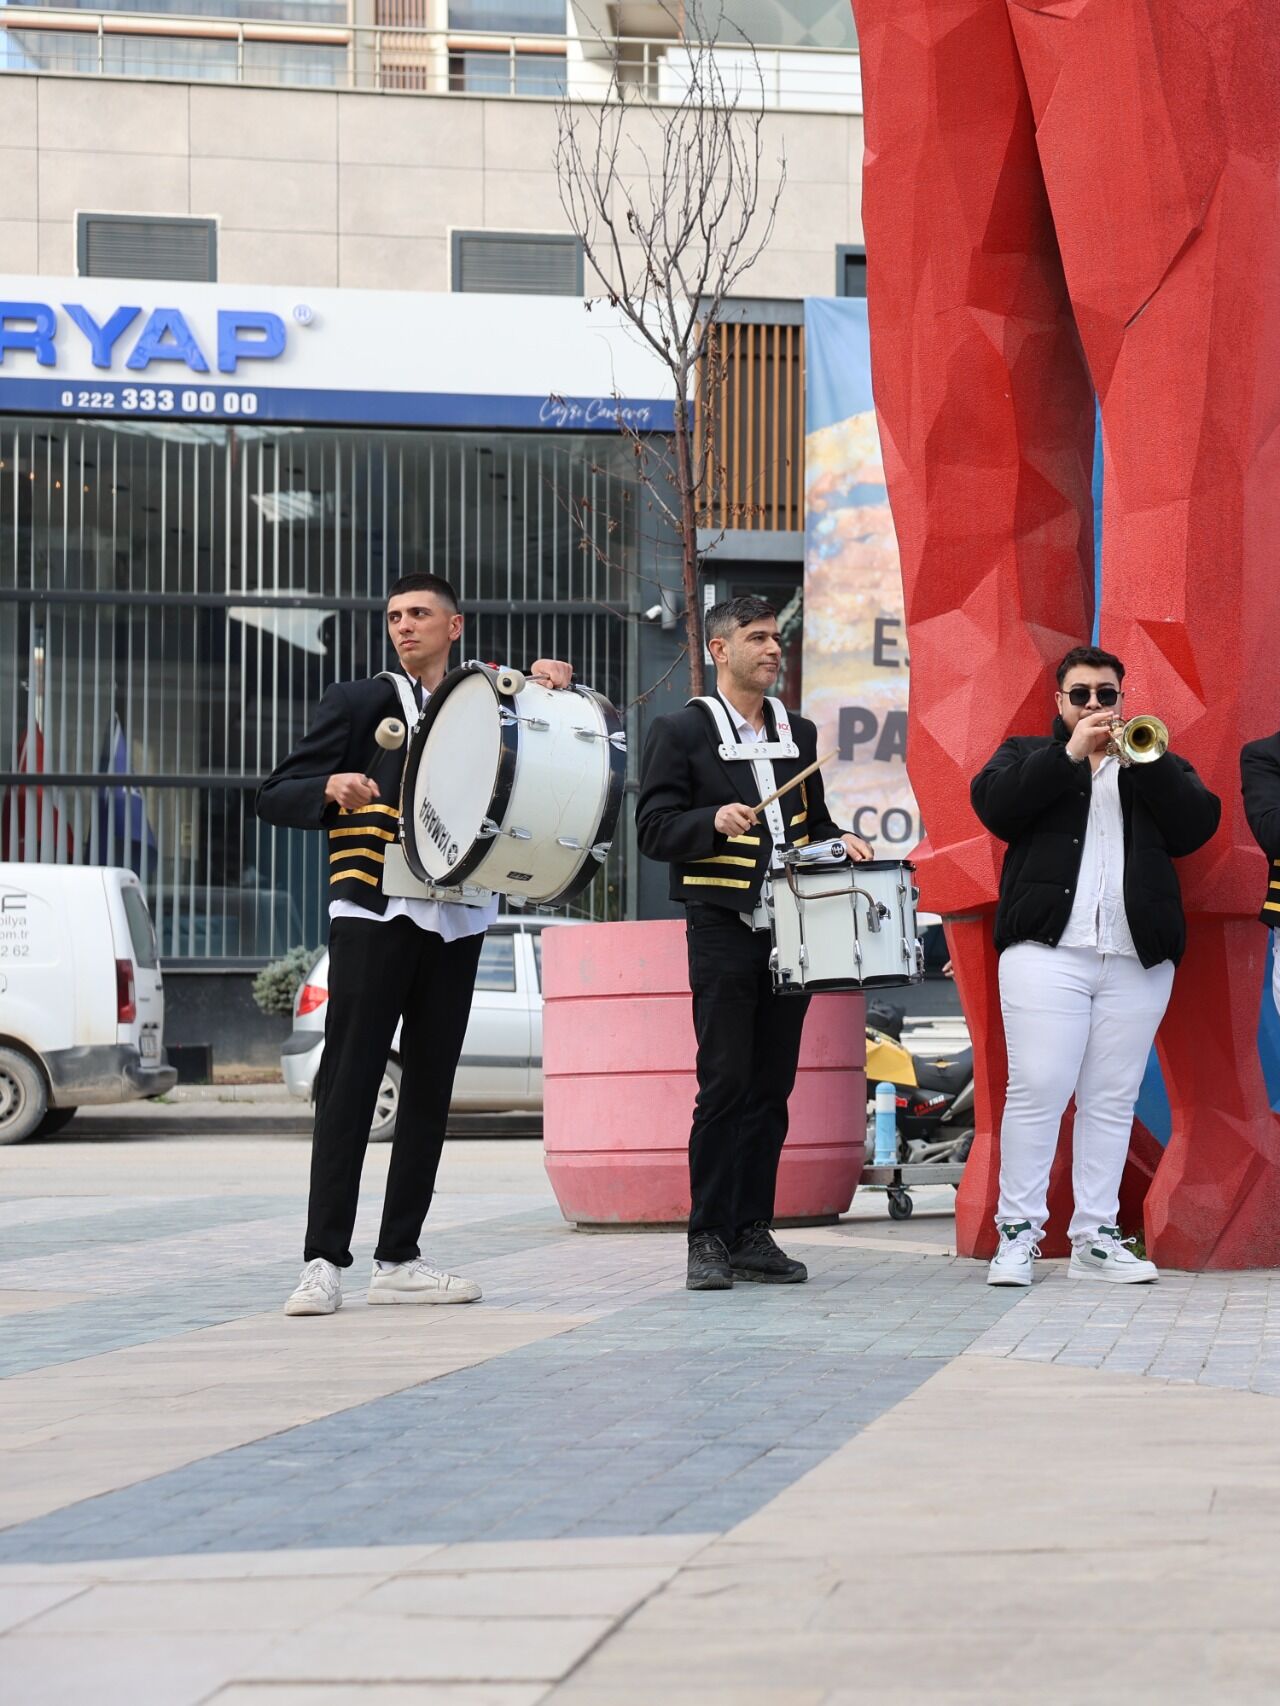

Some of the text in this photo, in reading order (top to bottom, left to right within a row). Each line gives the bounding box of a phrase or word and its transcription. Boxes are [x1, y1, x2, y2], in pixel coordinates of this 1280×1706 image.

[61, 388, 258, 414] 0 222 333 00 00
[419, 796, 452, 857] YAMAHA
[852, 805, 925, 844] CO
